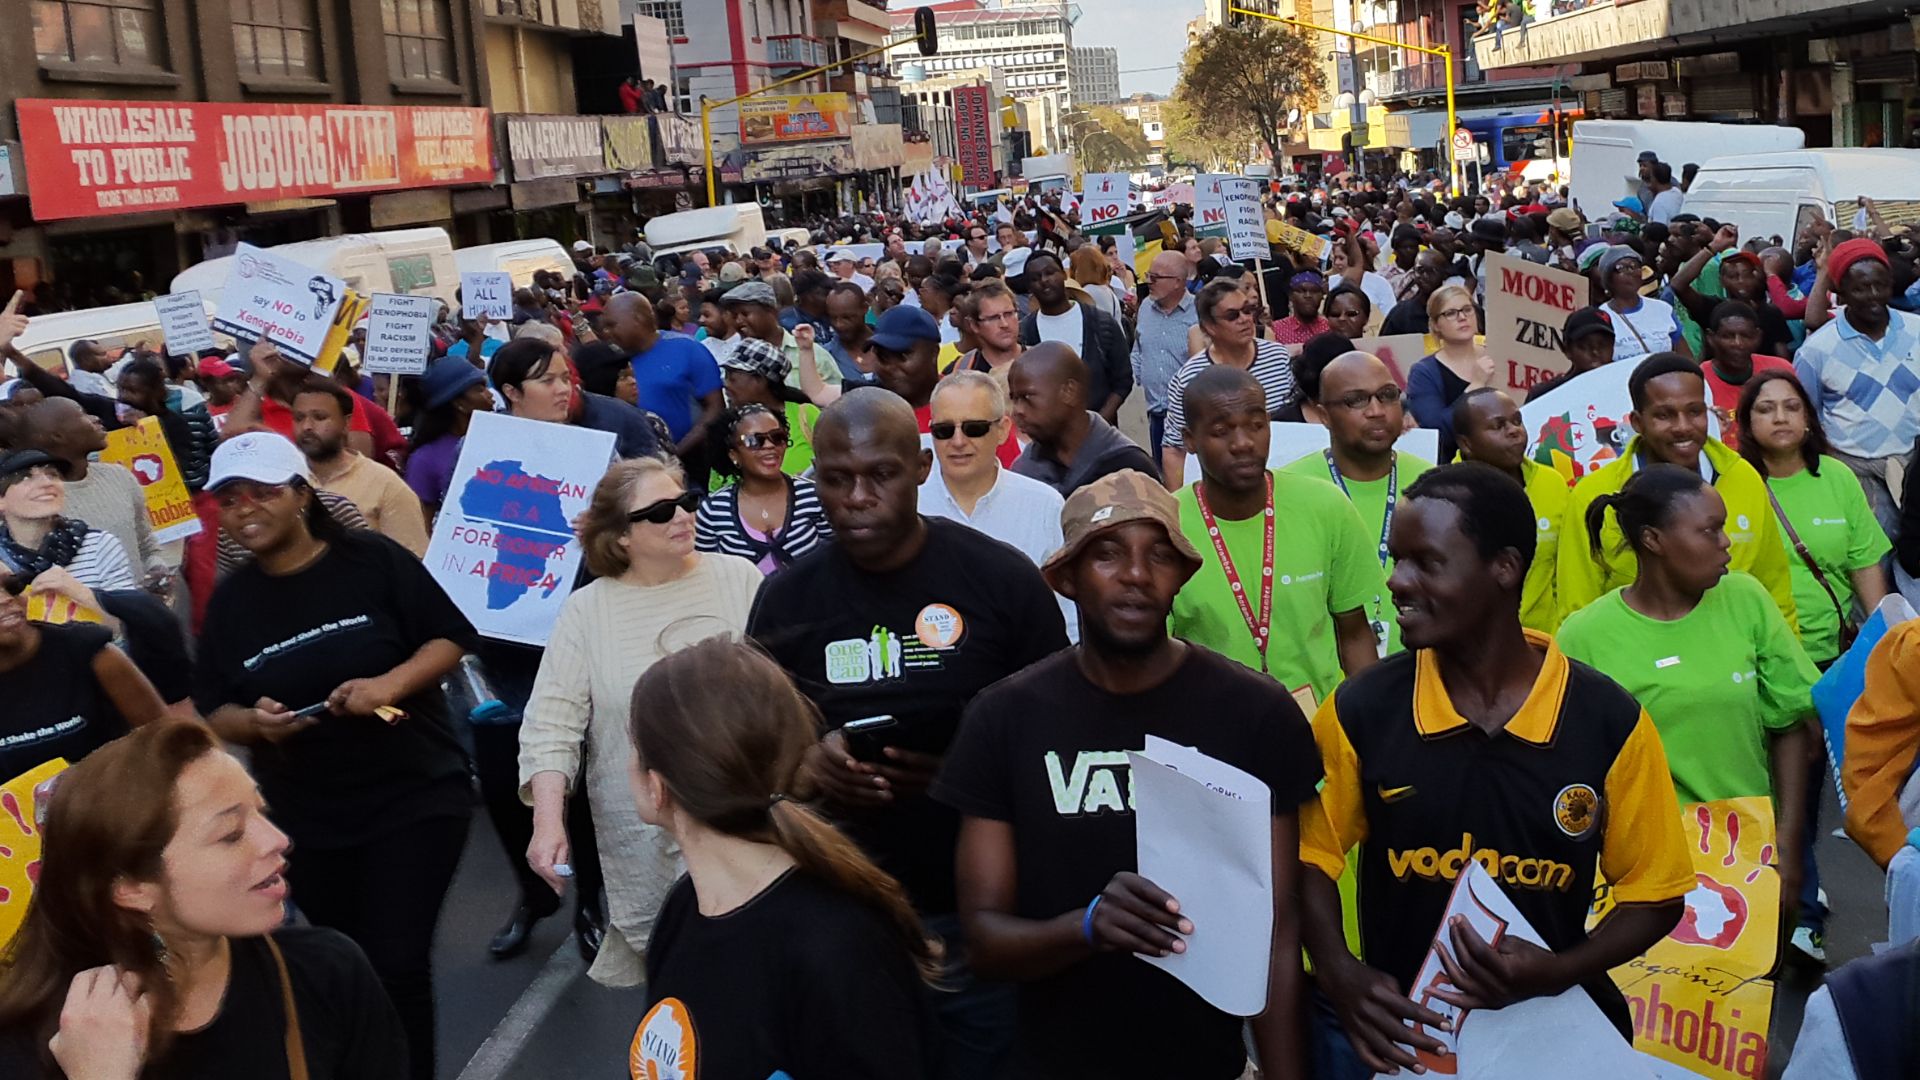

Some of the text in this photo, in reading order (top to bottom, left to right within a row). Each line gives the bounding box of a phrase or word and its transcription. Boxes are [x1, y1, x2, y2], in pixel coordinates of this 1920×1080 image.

[53, 106, 196, 144] WHOLESALE
[957, 91, 971, 141] SHOPPING
[220, 115, 328, 191] JOBURG
[415, 139, 476, 167] WELCOME
[507, 121, 535, 160] PAN
[971, 90, 990, 182] JOHANNESBURG
[71, 147, 192, 186] TO PUBLIC
[1091, 204, 1119, 221] NO
[389, 298, 415, 306] FIGHT
[474, 288, 497, 300] ALL
[1500, 267, 1576, 312] MORE
[236, 308, 305, 345] Xenophobia
[251, 295, 306, 322] say NO to
[372, 308, 428, 319] XENOPHOBIA
[385, 322, 414, 330] FIGHT
[380, 333, 416, 342] RACISM
[475, 467, 587, 499] NO AFRICAN
[501, 501, 540, 521] IS A
[451, 526, 566, 561] FOREIGNER
[441, 553, 556, 592] IN AFRICA
[924, 614, 950, 622] STAND
[1261, 585, 1272, 623] harambee
[262, 614, 369, 654] out and Shake the World
[828, 642, 863, 657] one
[829, 665, 865, 680] can
[6, 730, 36, 745] Shake
[36, 723, 55, 737] the
[1044, 750, 1144, 814] VA
[1387, 832, 1573, 888] vodacom
[1622, 955, 1774, 998] against
[642, 1029, 677, 1067] STAND
